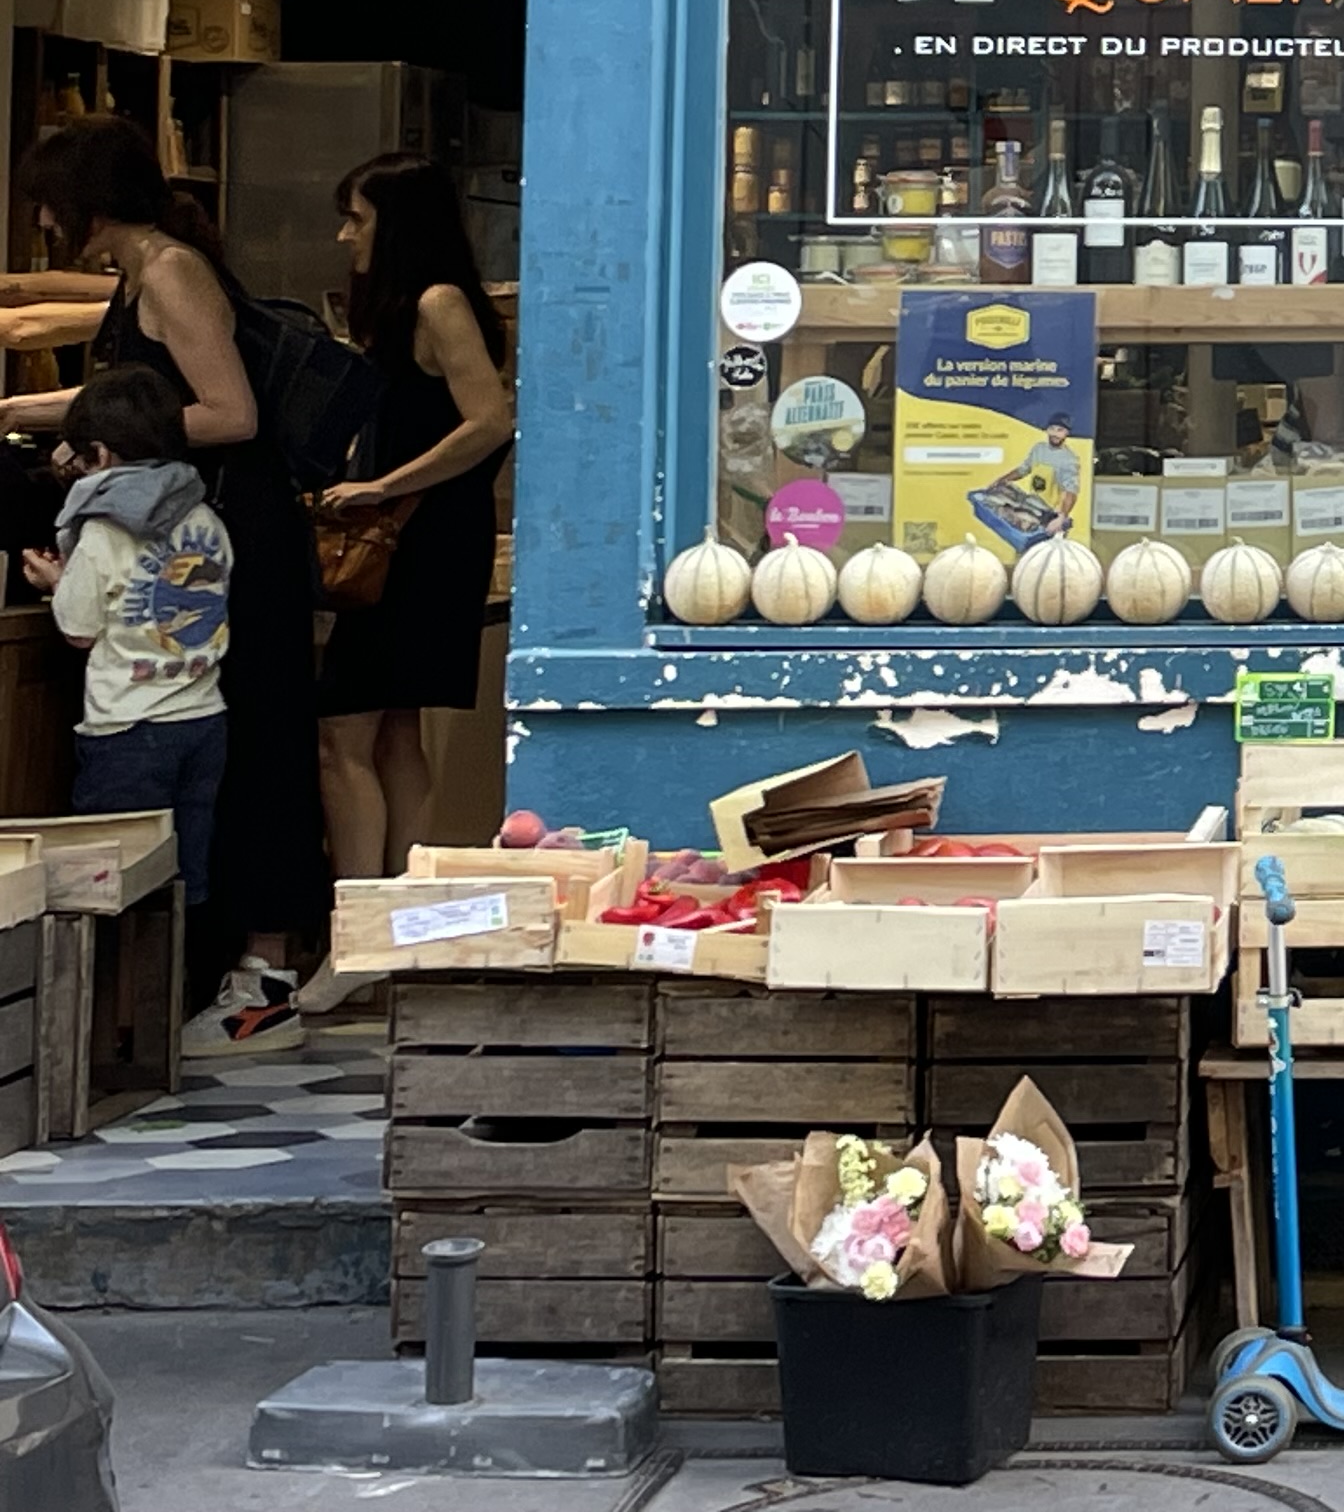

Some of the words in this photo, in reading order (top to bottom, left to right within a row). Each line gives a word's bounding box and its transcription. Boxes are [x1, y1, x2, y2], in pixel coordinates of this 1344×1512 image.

[914, 35, 957, 56] EN
[972, 36, 1088, 57] DIRECT
[1101, 36, 1147, 57] DU
[936, 358, 954, 372] La
[956, 358, 1008, 373] version
